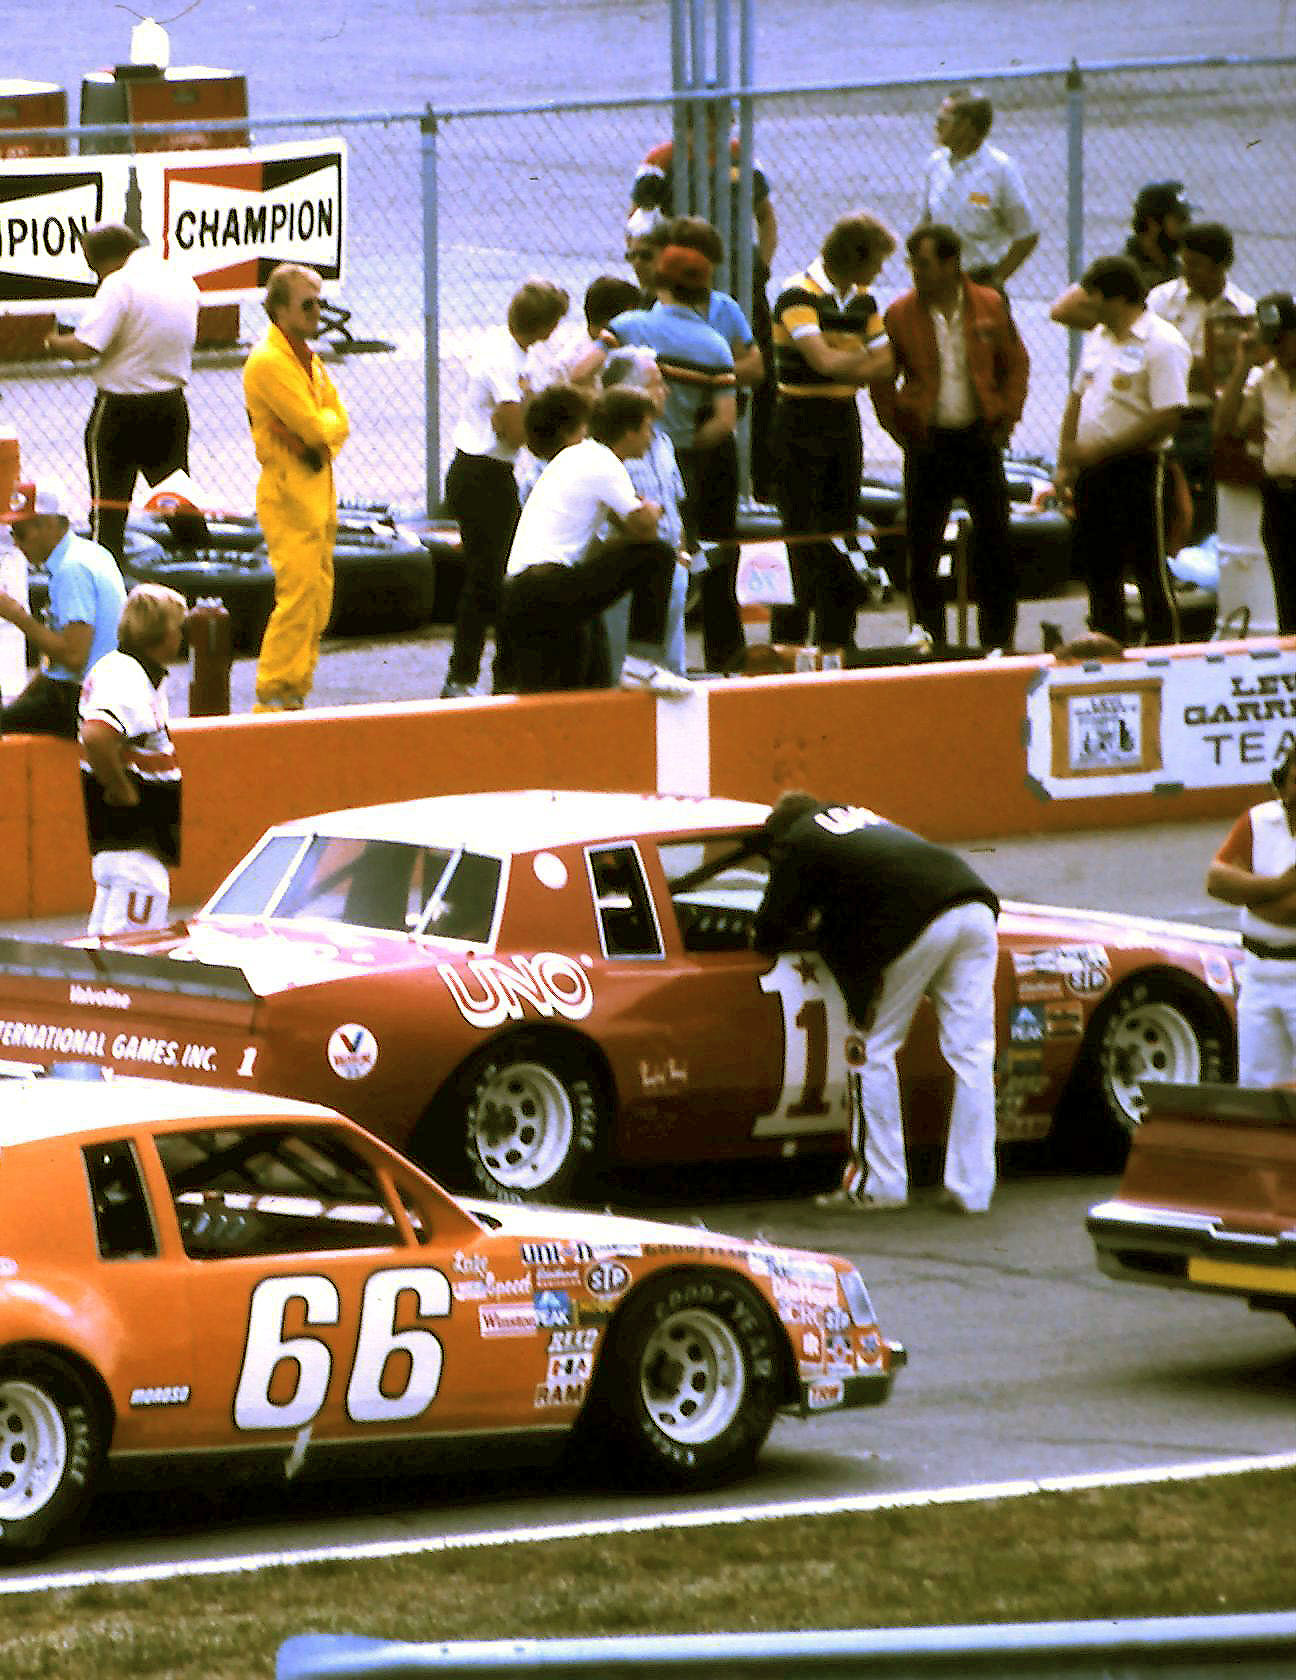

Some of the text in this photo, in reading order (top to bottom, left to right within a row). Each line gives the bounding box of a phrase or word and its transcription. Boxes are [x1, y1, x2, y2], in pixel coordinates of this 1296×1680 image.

[175, 197, 333, 251] CHAMPION
[1202, 730, 1296, 766] TEA
[127, 891, 154, 925] U
[436, 952, 594, 1028] UNO
[181, 1043, 218, 1072] INC.
[237, 1046, 257, 1077] 1
[752, 952, 850, 1138] 1
[589, 1263, 627, 1293] STP
[232, 1265, 453, 1431] 66
